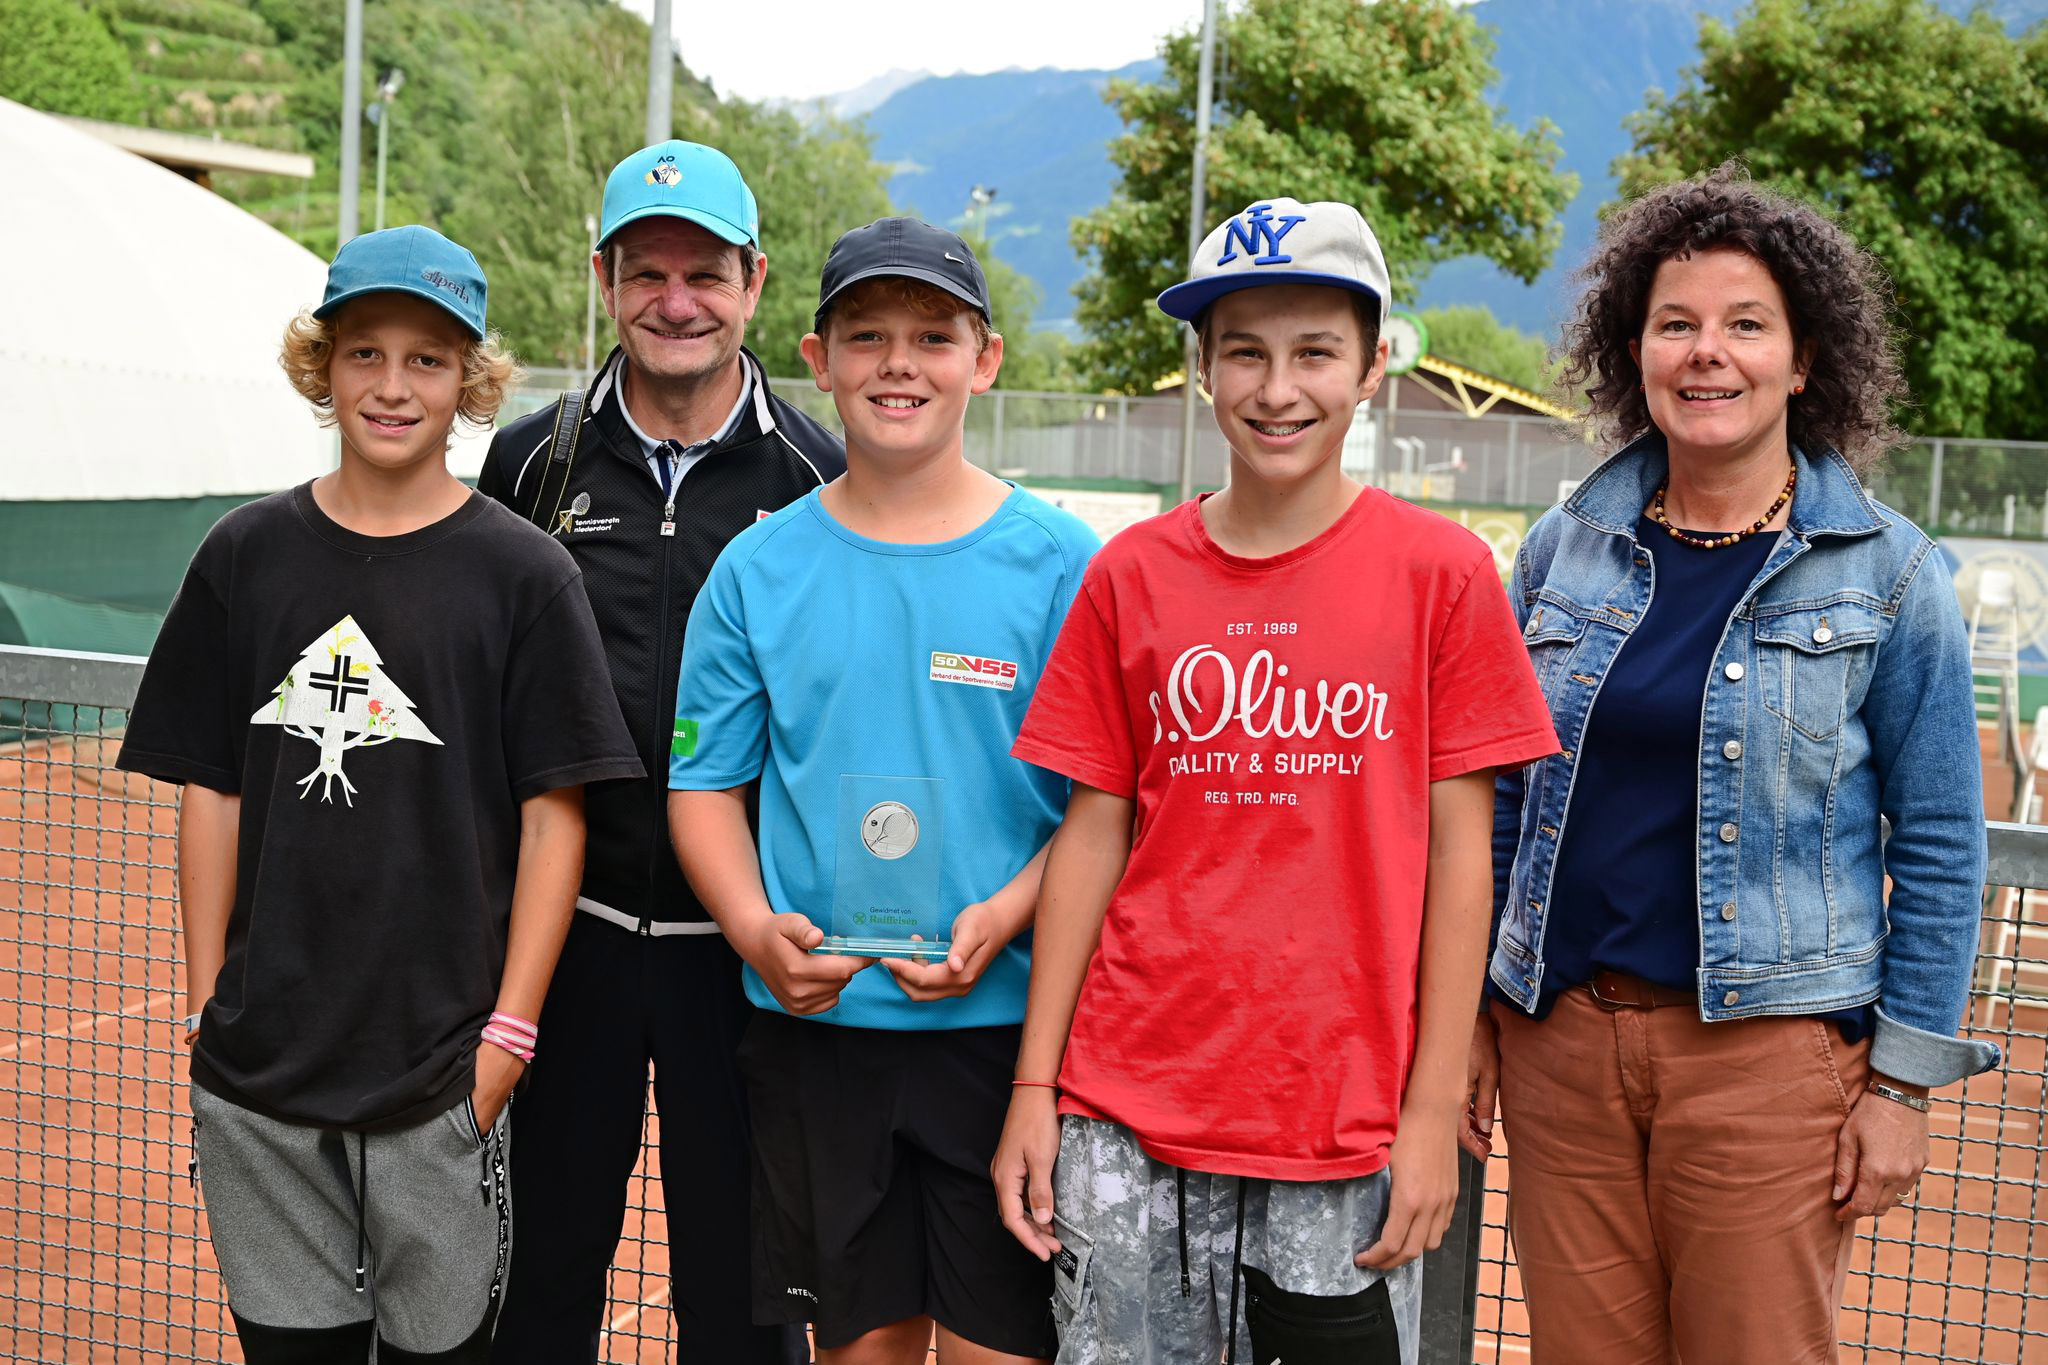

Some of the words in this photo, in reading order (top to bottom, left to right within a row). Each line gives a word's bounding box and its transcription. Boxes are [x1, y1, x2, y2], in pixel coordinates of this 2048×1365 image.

[1216, 204, 1307, 267] NY
[1226, 622, 1257, 636] EST.
[1263, 622, 1298, 635] 1969
[960, 656, 1016, 678] VSS
[1249, 753, 1264, 774] &
[1274, 753, 1364, 775] SUPPLY
[1204, 791, 1231, 804] REG.
[1235, 792, 1265, 805] TRD.
[1269, 793, 1300, 806] MFG.
